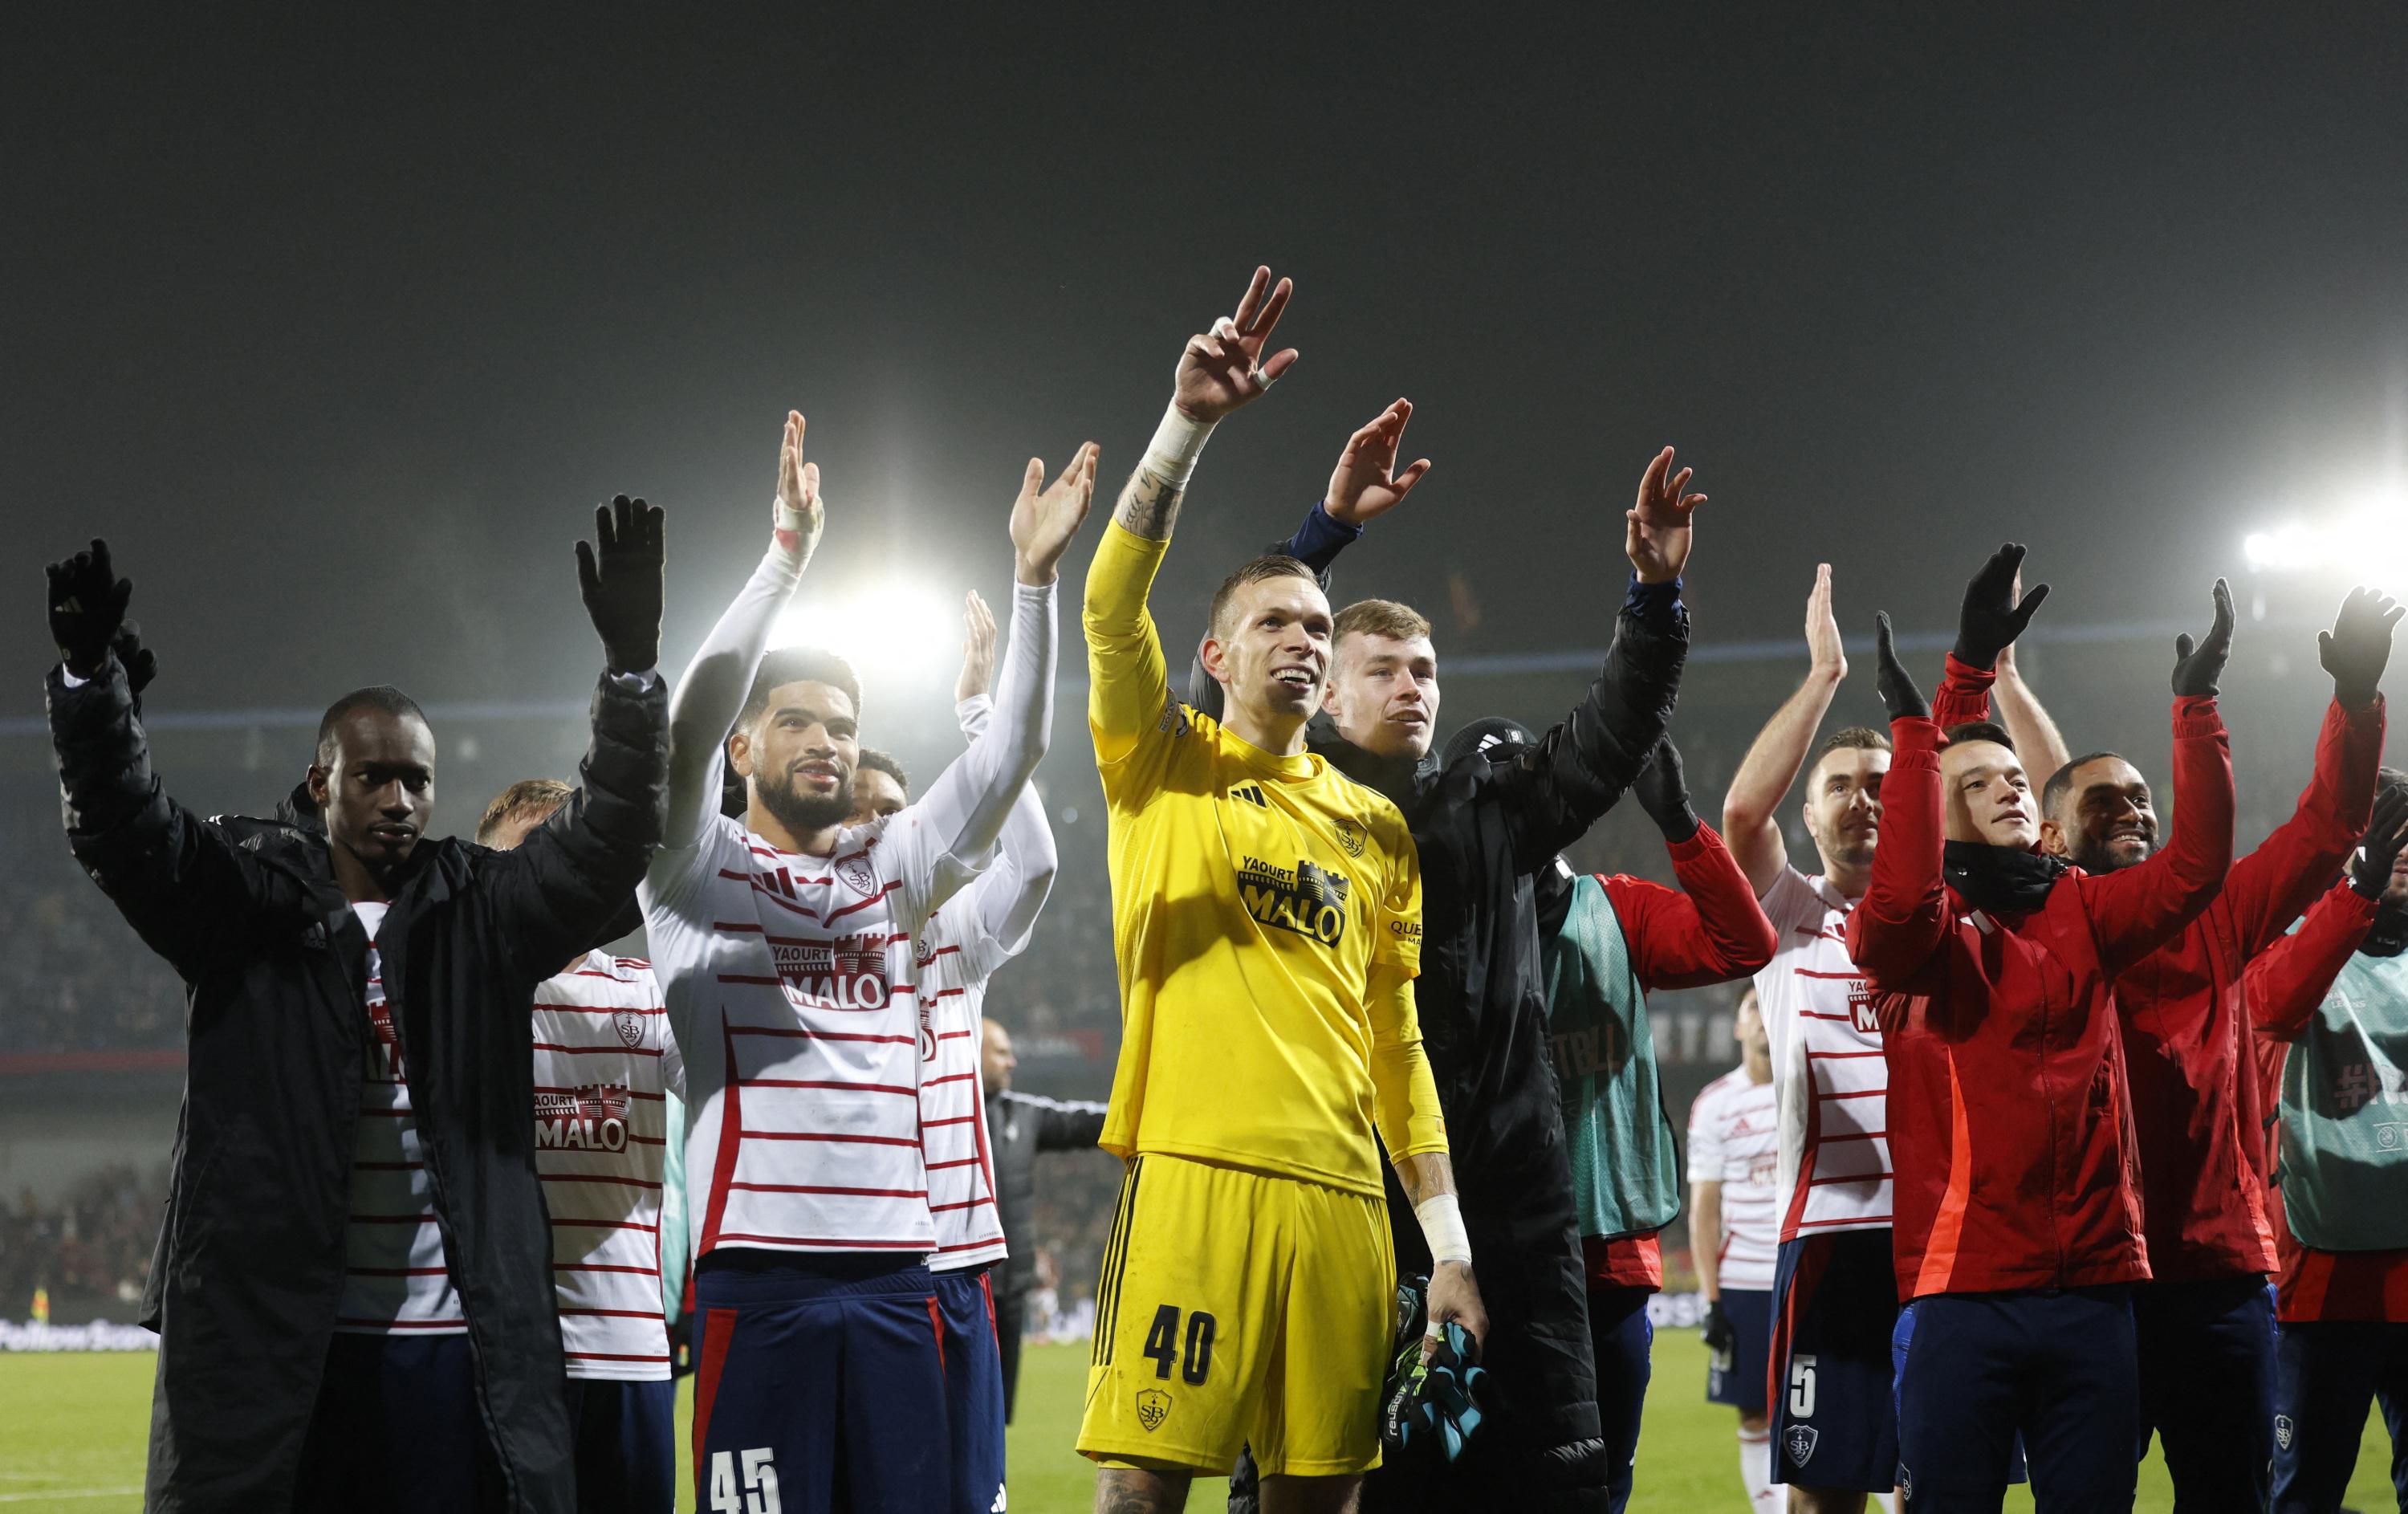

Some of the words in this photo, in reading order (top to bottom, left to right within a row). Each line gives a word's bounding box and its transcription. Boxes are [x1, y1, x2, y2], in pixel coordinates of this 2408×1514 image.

[1243, 856, 1295, 881] YAOURT
[1244, 885, 1341, 942] MALO
[1391, 921, 1422, 936] QUE
[772, 946, 831, 961] YAOURT
[1408, 937, 1421, 946] MA
[782, 973, 885, 1009] MALO
[1849, 981, 1868, 992] YA
[535, 1094, 575, 1107] AOURT
[535, 1118, 626, 1151] MALO
[1143, 1304, 1217, 1386] 40
[1790, 1353, 1817, 1418] 5
[1389, 1390, 1405, 1437] reusch
[710, 1447, 782, 1514] 45
